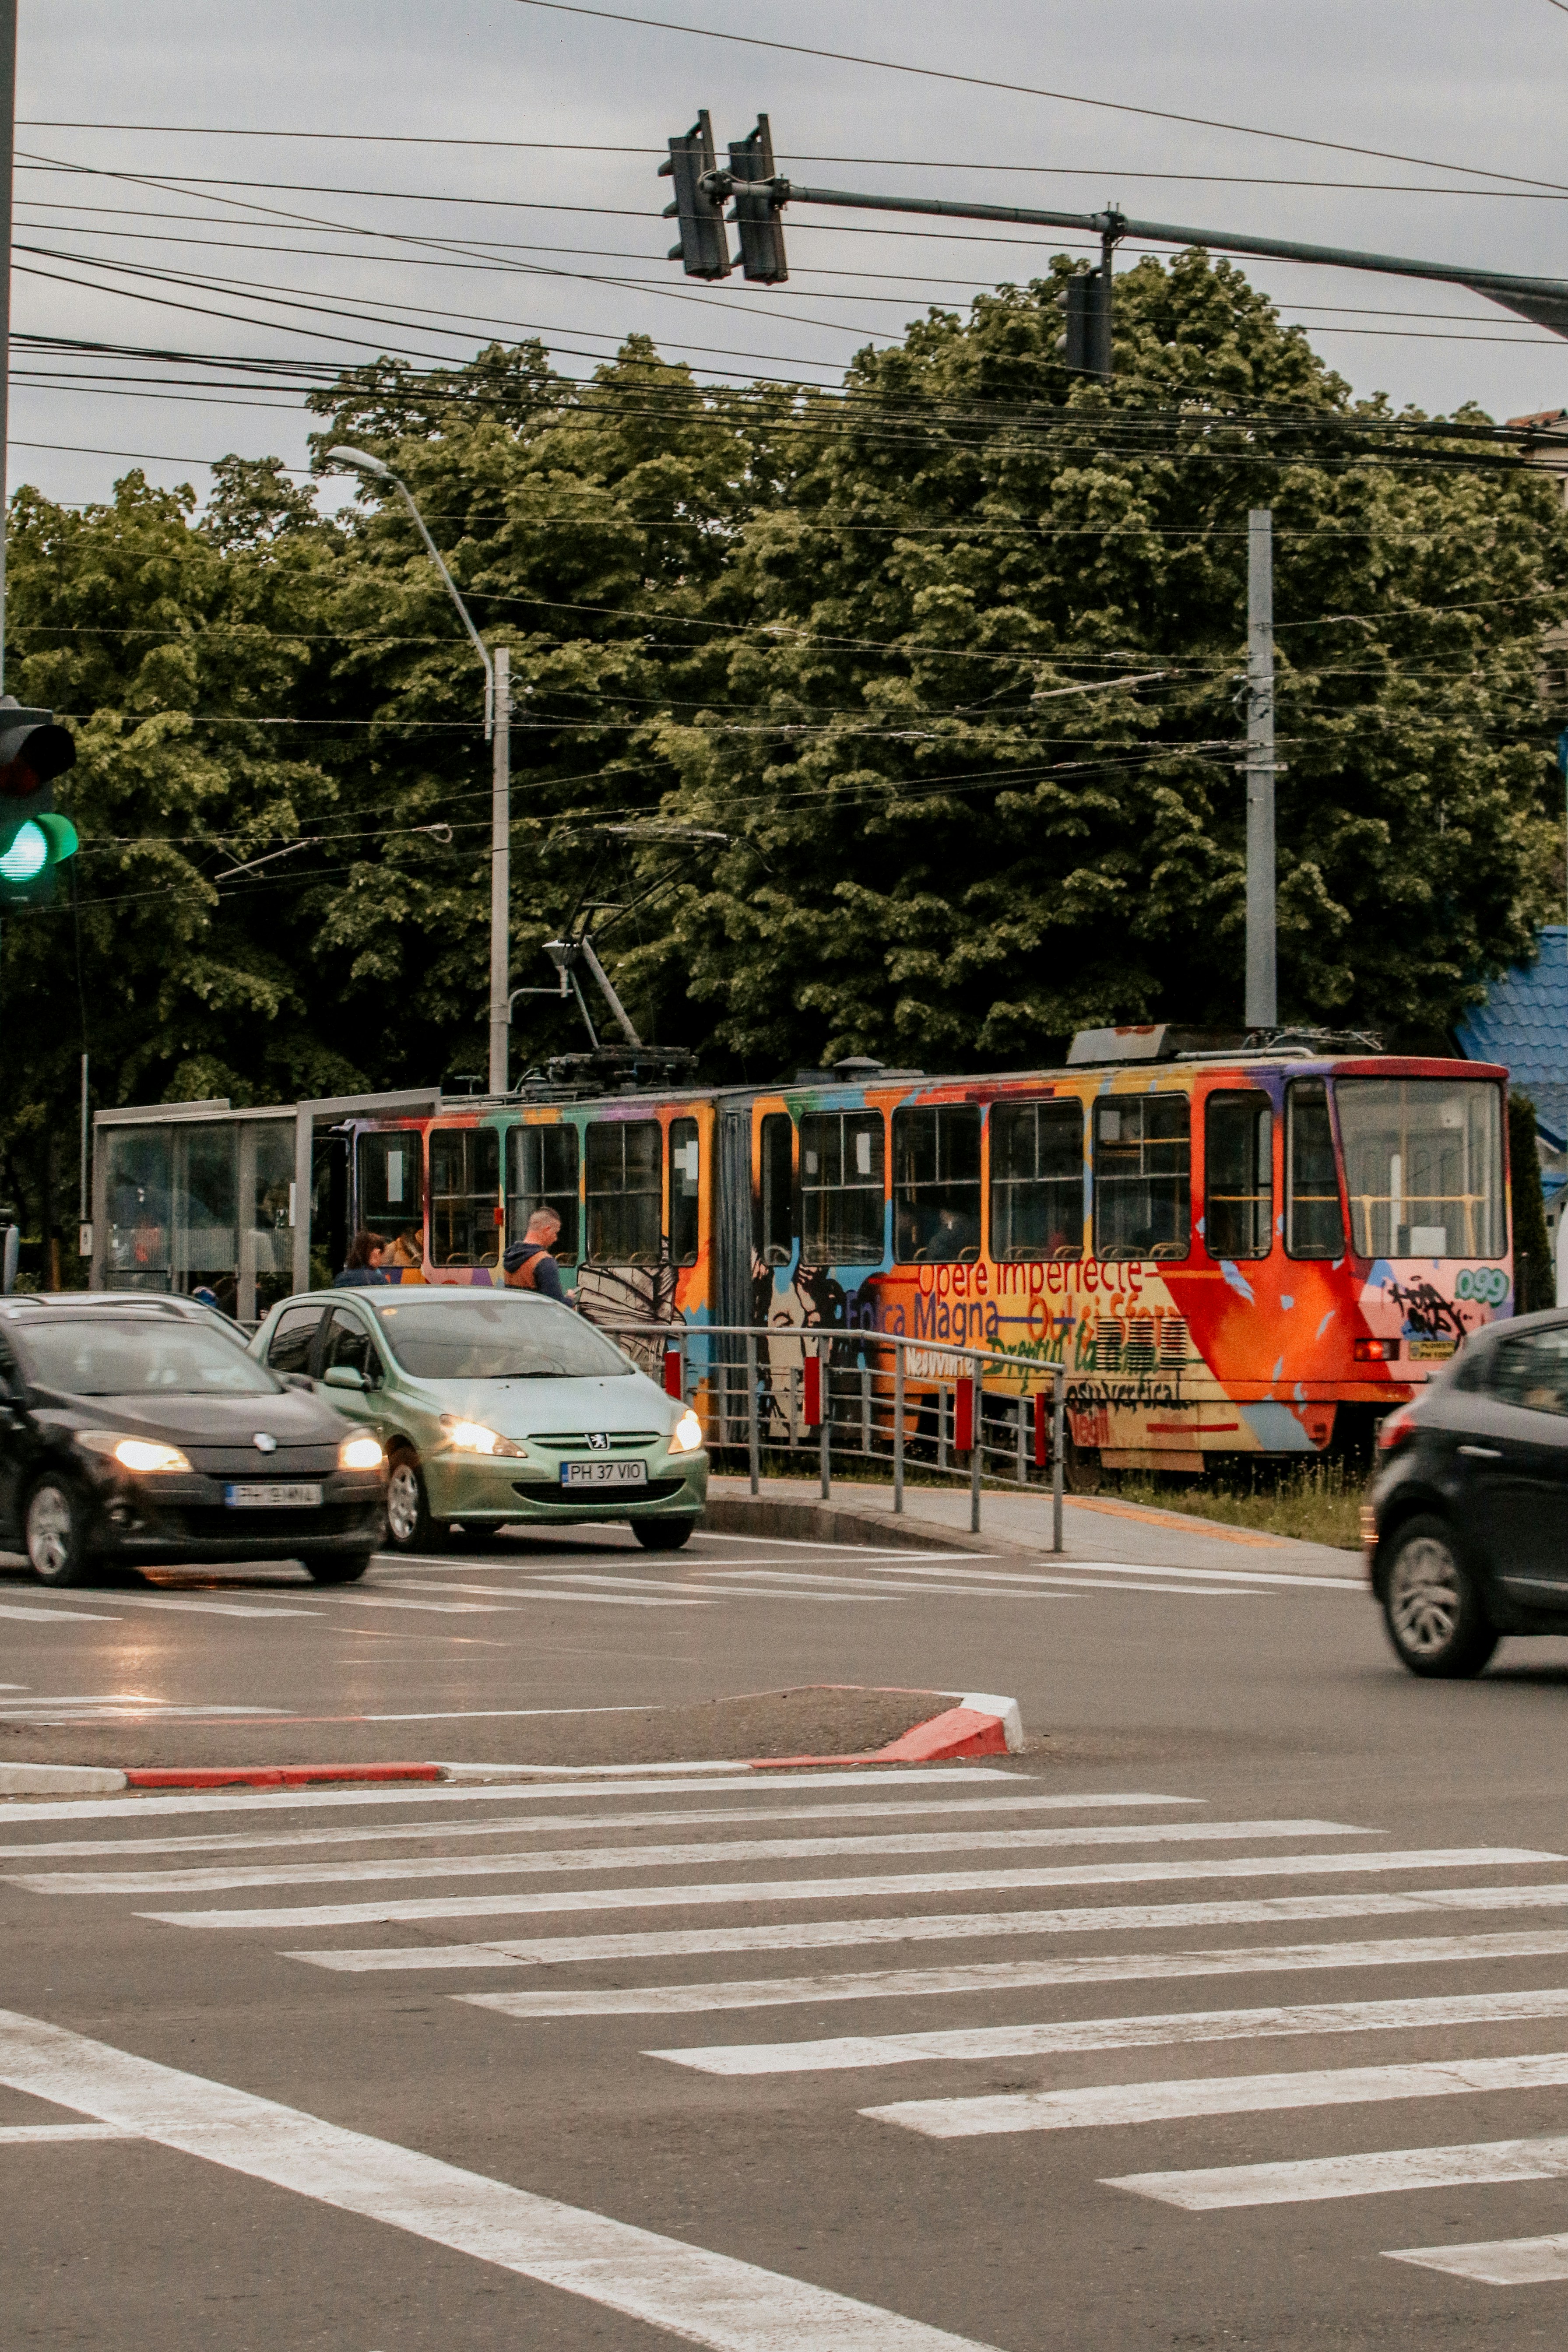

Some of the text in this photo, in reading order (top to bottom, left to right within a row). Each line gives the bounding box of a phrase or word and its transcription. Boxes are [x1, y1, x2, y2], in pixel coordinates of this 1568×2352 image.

[919, 1257, 1142, 1306] Opere Imperfecte
[1455, 1266, 1509, 1308] 099
[914, 1291, 998, 1347] Magna
[571, 1464, 640, 1480] PH 37 VIO
